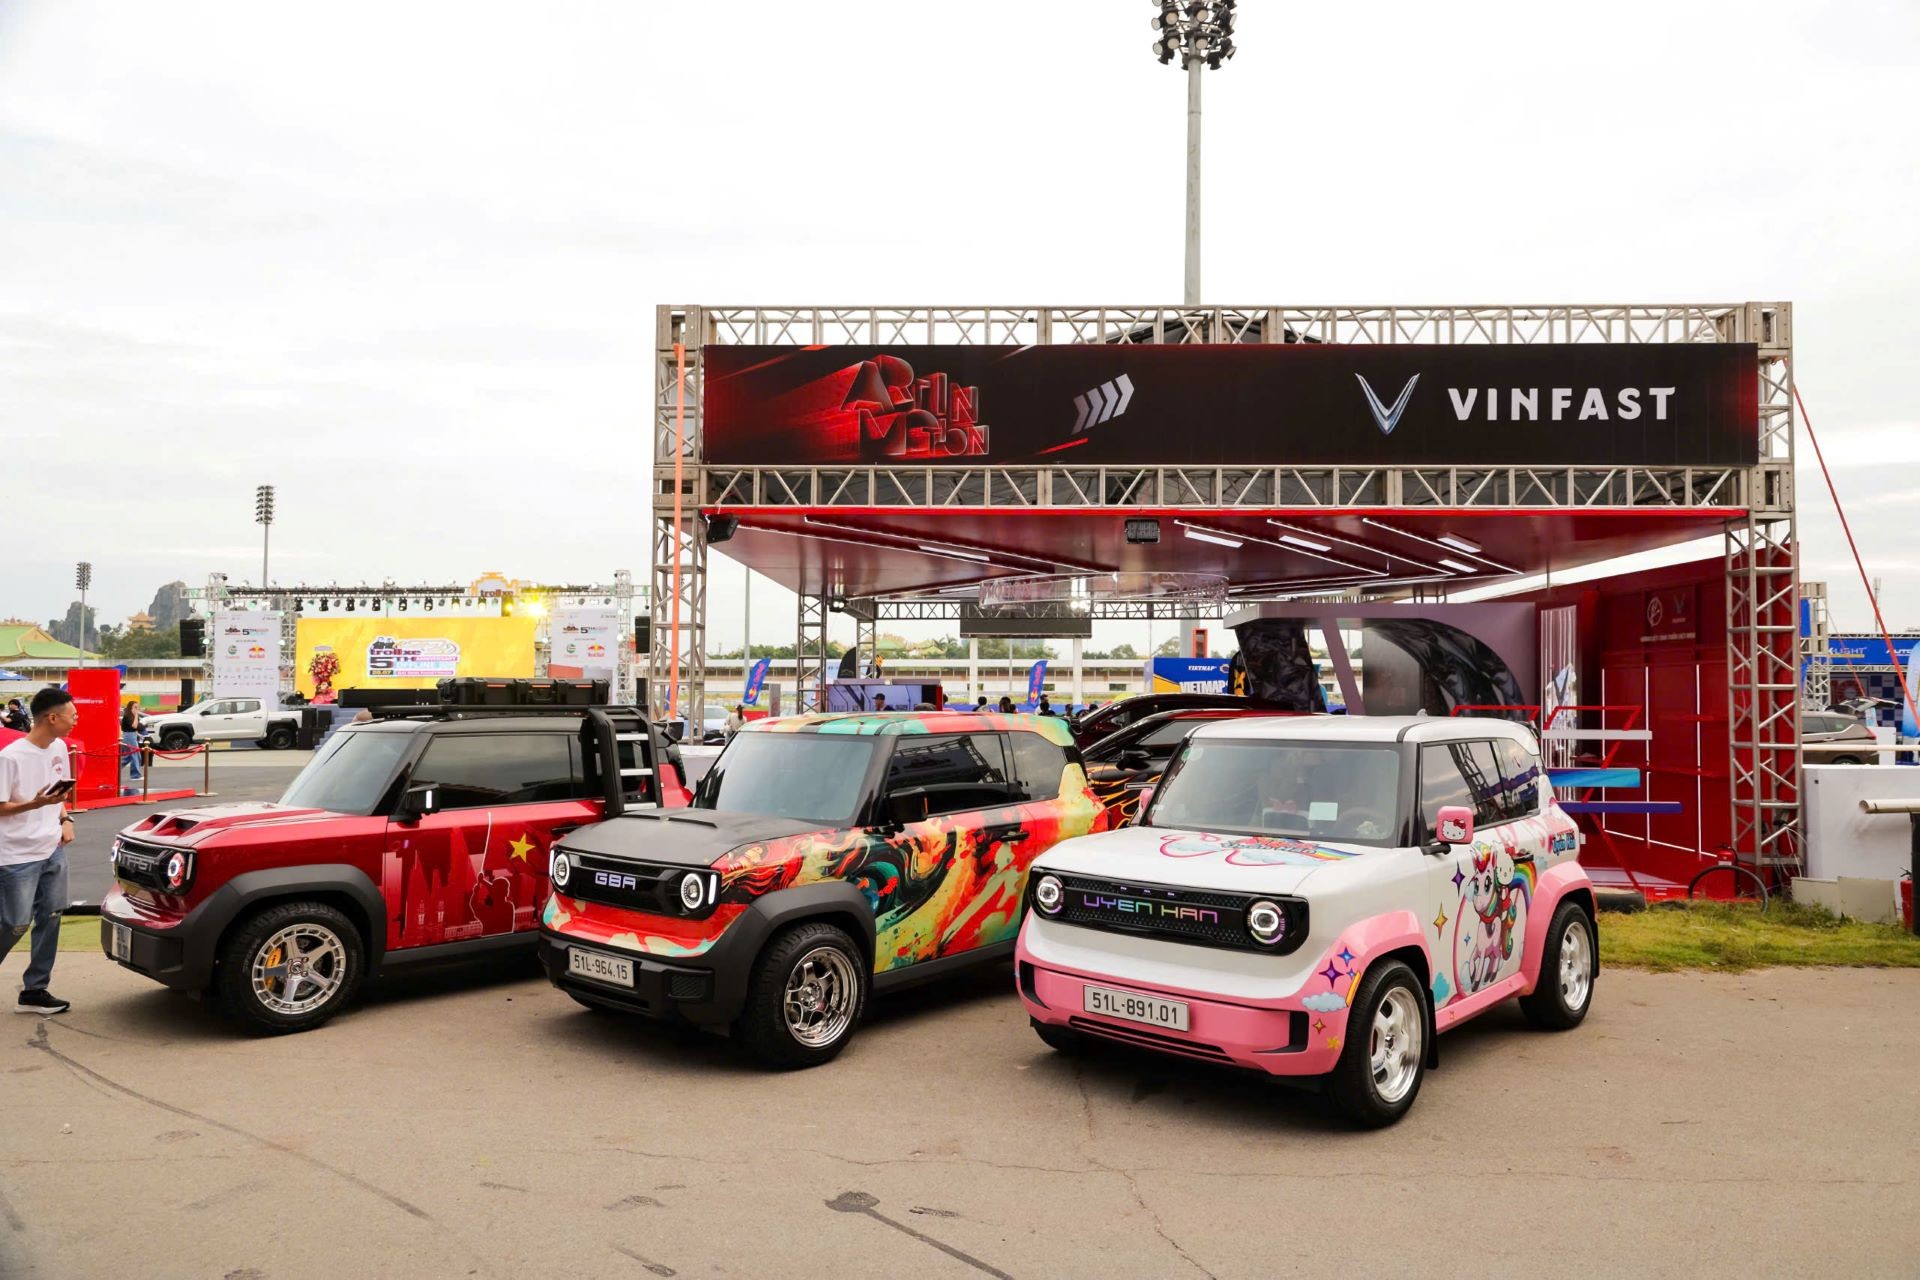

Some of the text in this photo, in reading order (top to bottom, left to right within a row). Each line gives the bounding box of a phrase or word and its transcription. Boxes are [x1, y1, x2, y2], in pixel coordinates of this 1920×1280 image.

[935, 372, 978, 424] IN
[1447, 386, 1676, 421] VINFAST
[858, 408, 990, 456] MOTION
[1179, 681, 1226, 694] VIETMAP
[594, 872, 636, 890] GBA
[1083, 894, 1218, 924] UYEN HAN
[574, 954, 628, 980] 51L-964.15
[1092, 991, 1177, 1024] 51L-891.01
